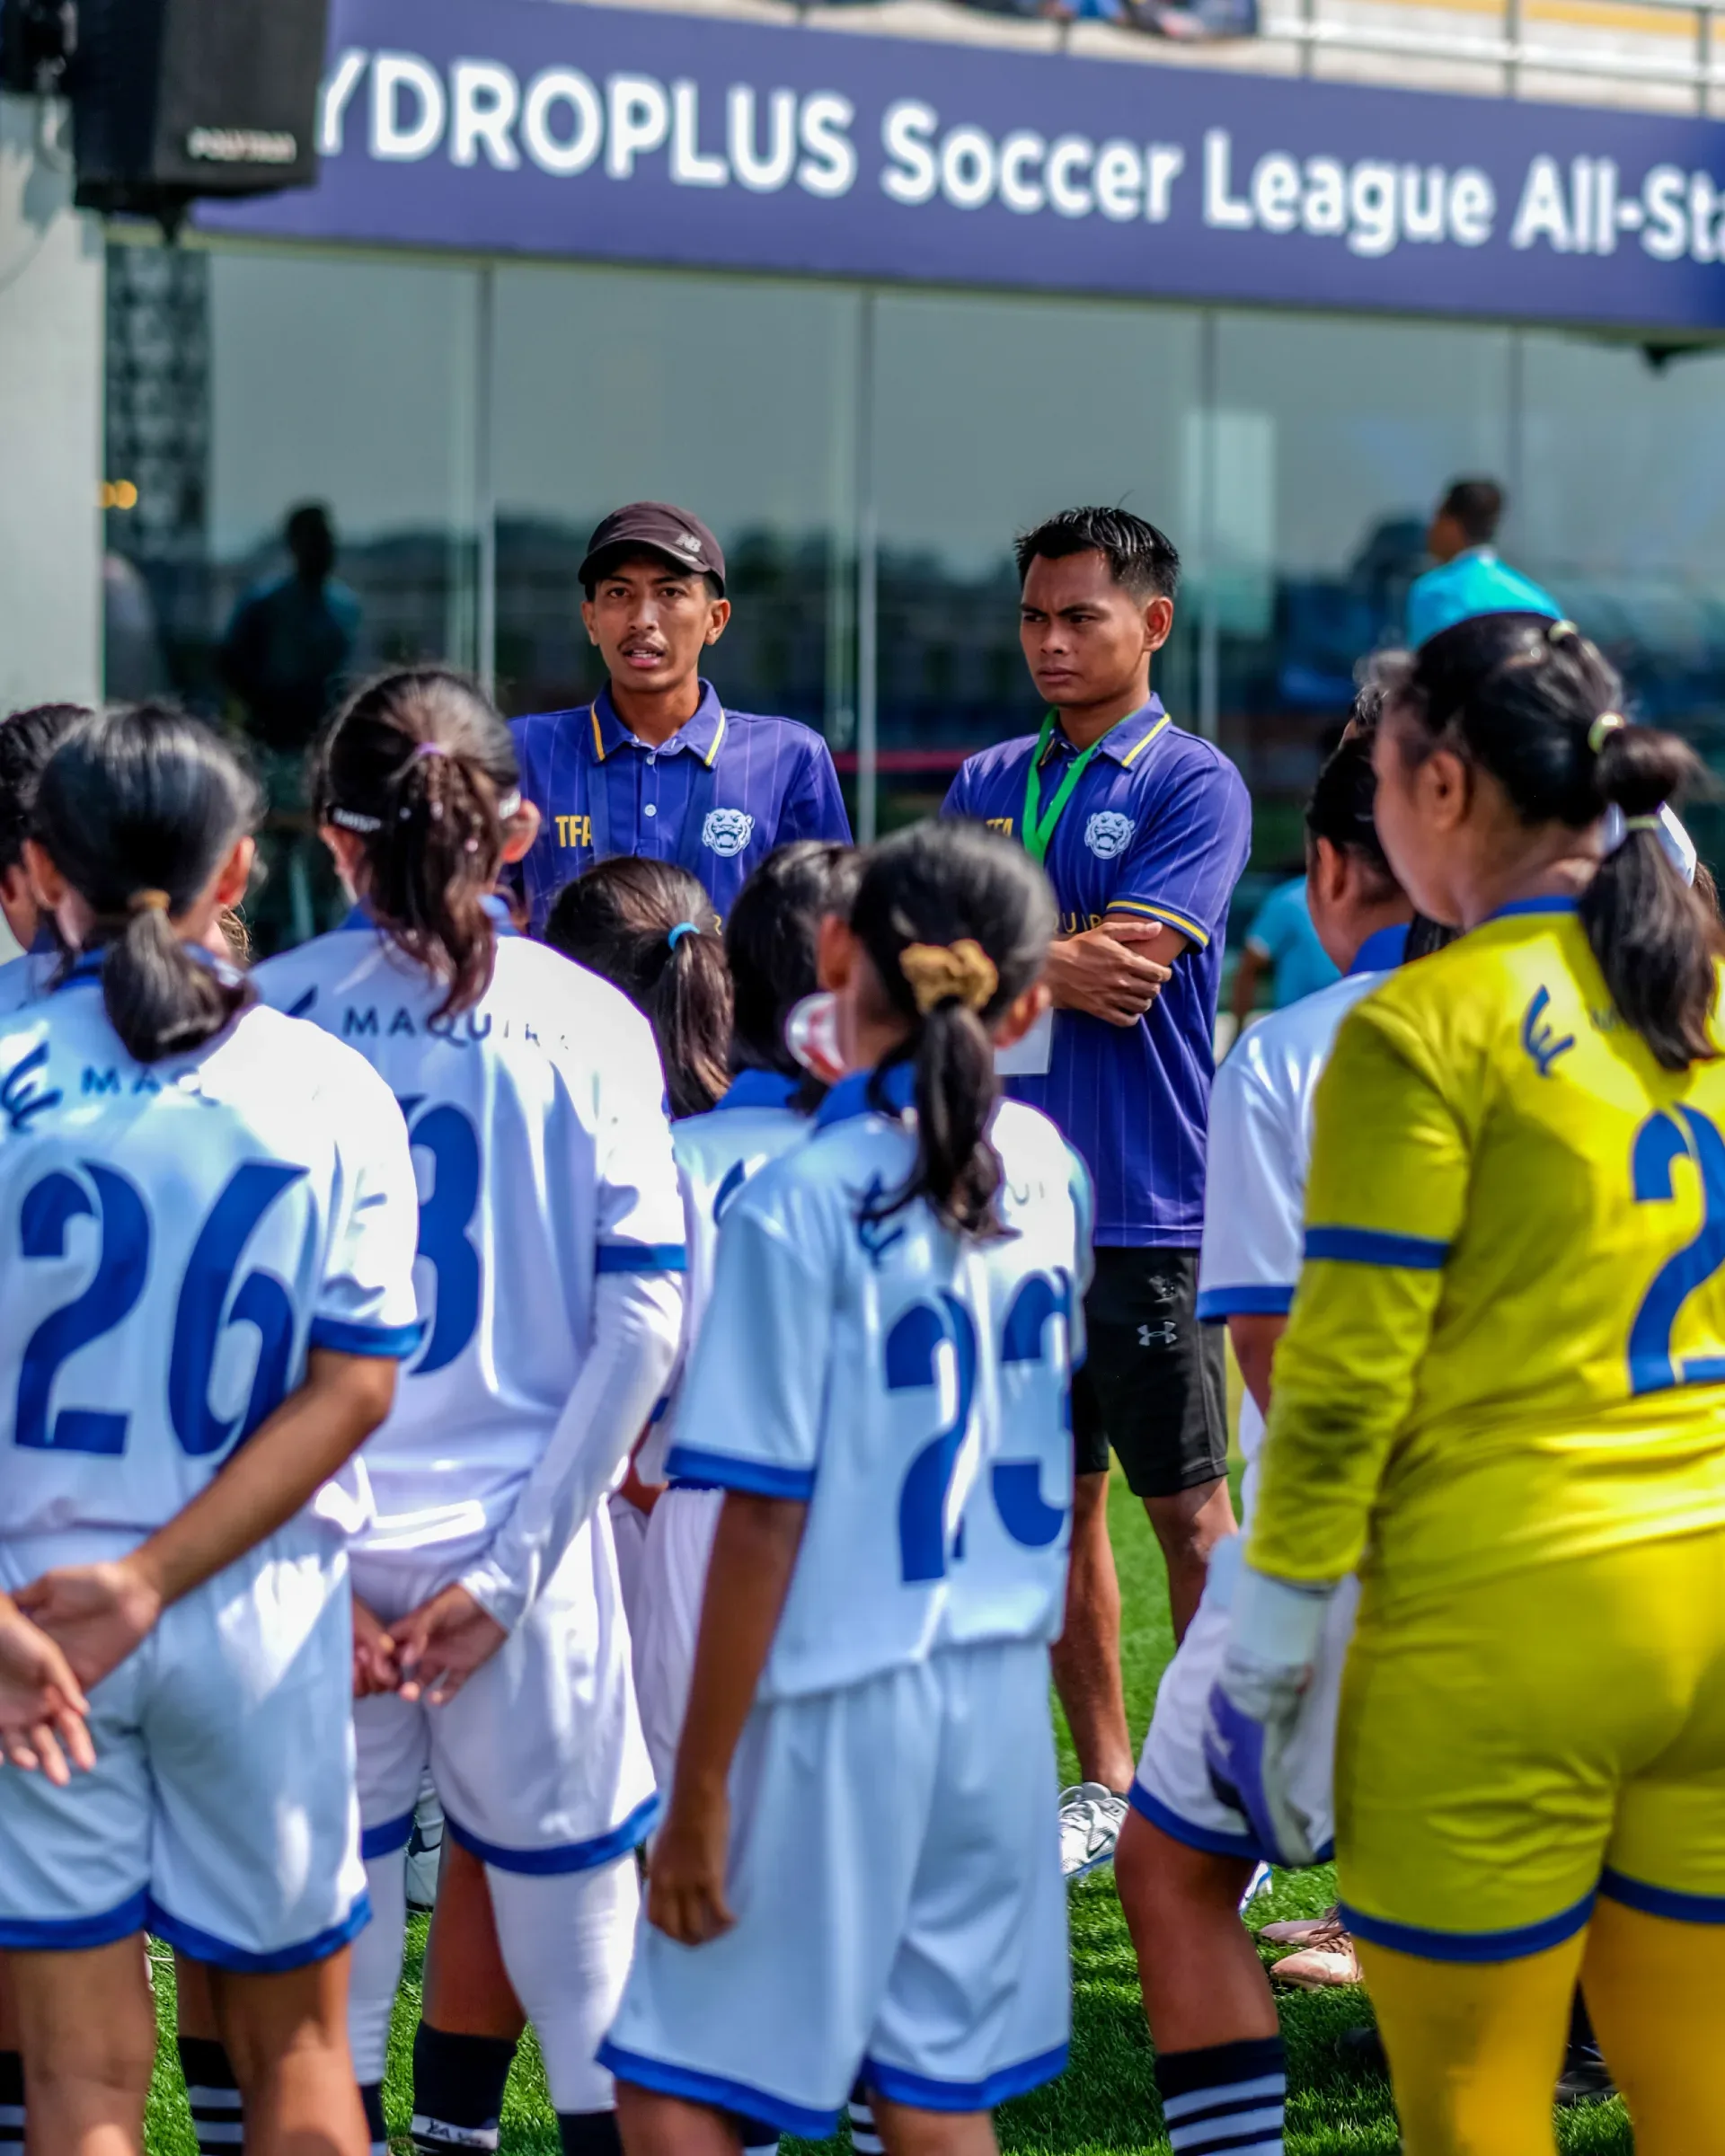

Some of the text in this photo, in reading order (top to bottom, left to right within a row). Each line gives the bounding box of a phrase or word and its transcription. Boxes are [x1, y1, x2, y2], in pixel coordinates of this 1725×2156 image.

[881, 98, 1185, 224] Soccer
[1202, 126, 1495, 259] League
[1509, 152, 1725, 266] All-St
[14, 1158, 311, 1456] 26
